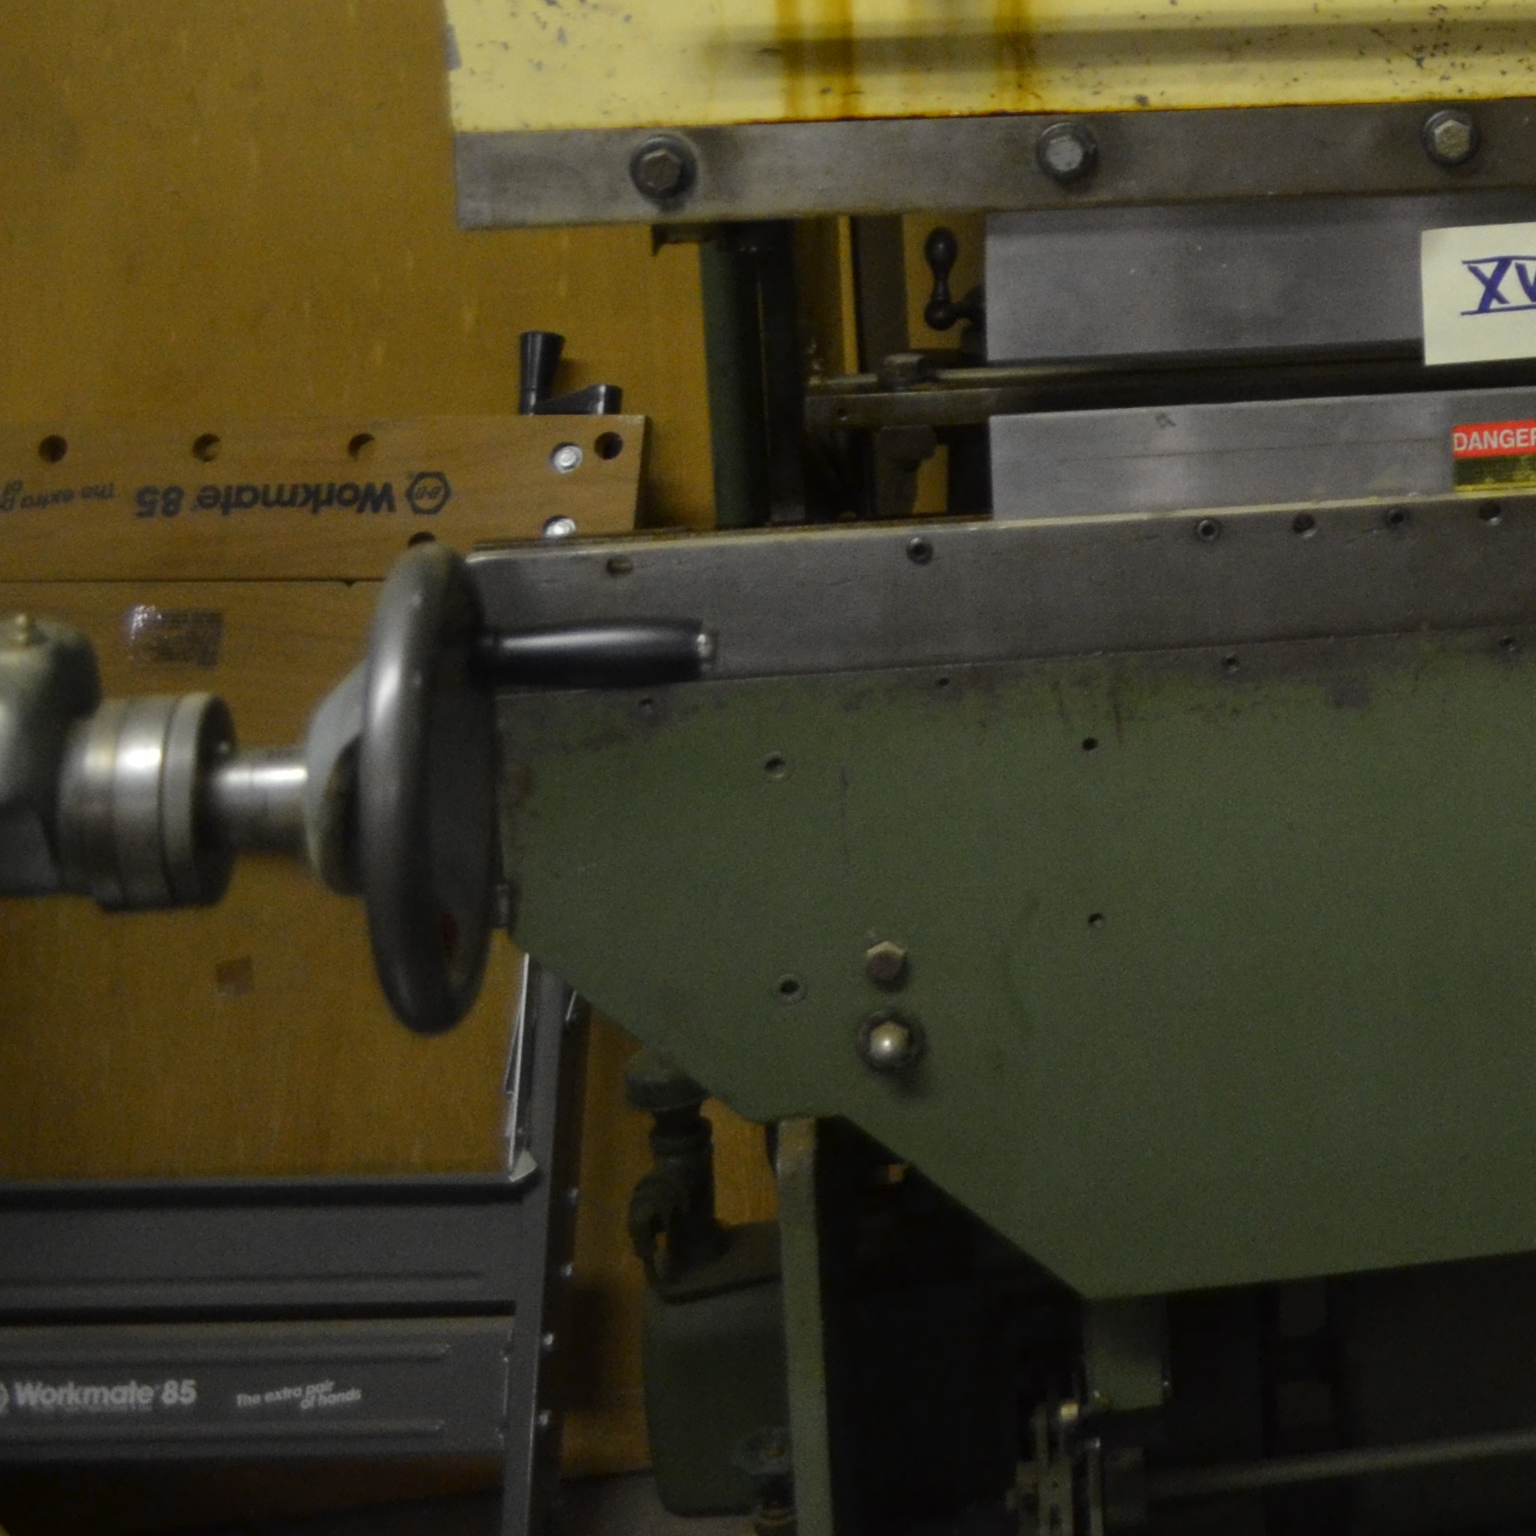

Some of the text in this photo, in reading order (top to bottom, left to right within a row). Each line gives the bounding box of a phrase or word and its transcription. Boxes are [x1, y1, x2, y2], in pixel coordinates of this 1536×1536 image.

[134, 484, 186, 519] 85
[197, 481, 397, 517] Workmate
[15, 1379, 197, 1408] Workmate 85
[264, 1386, 302, 1404] extra
[305, 1379, 335, 1399] pair
[318, 1388, 362, 1407] hands
